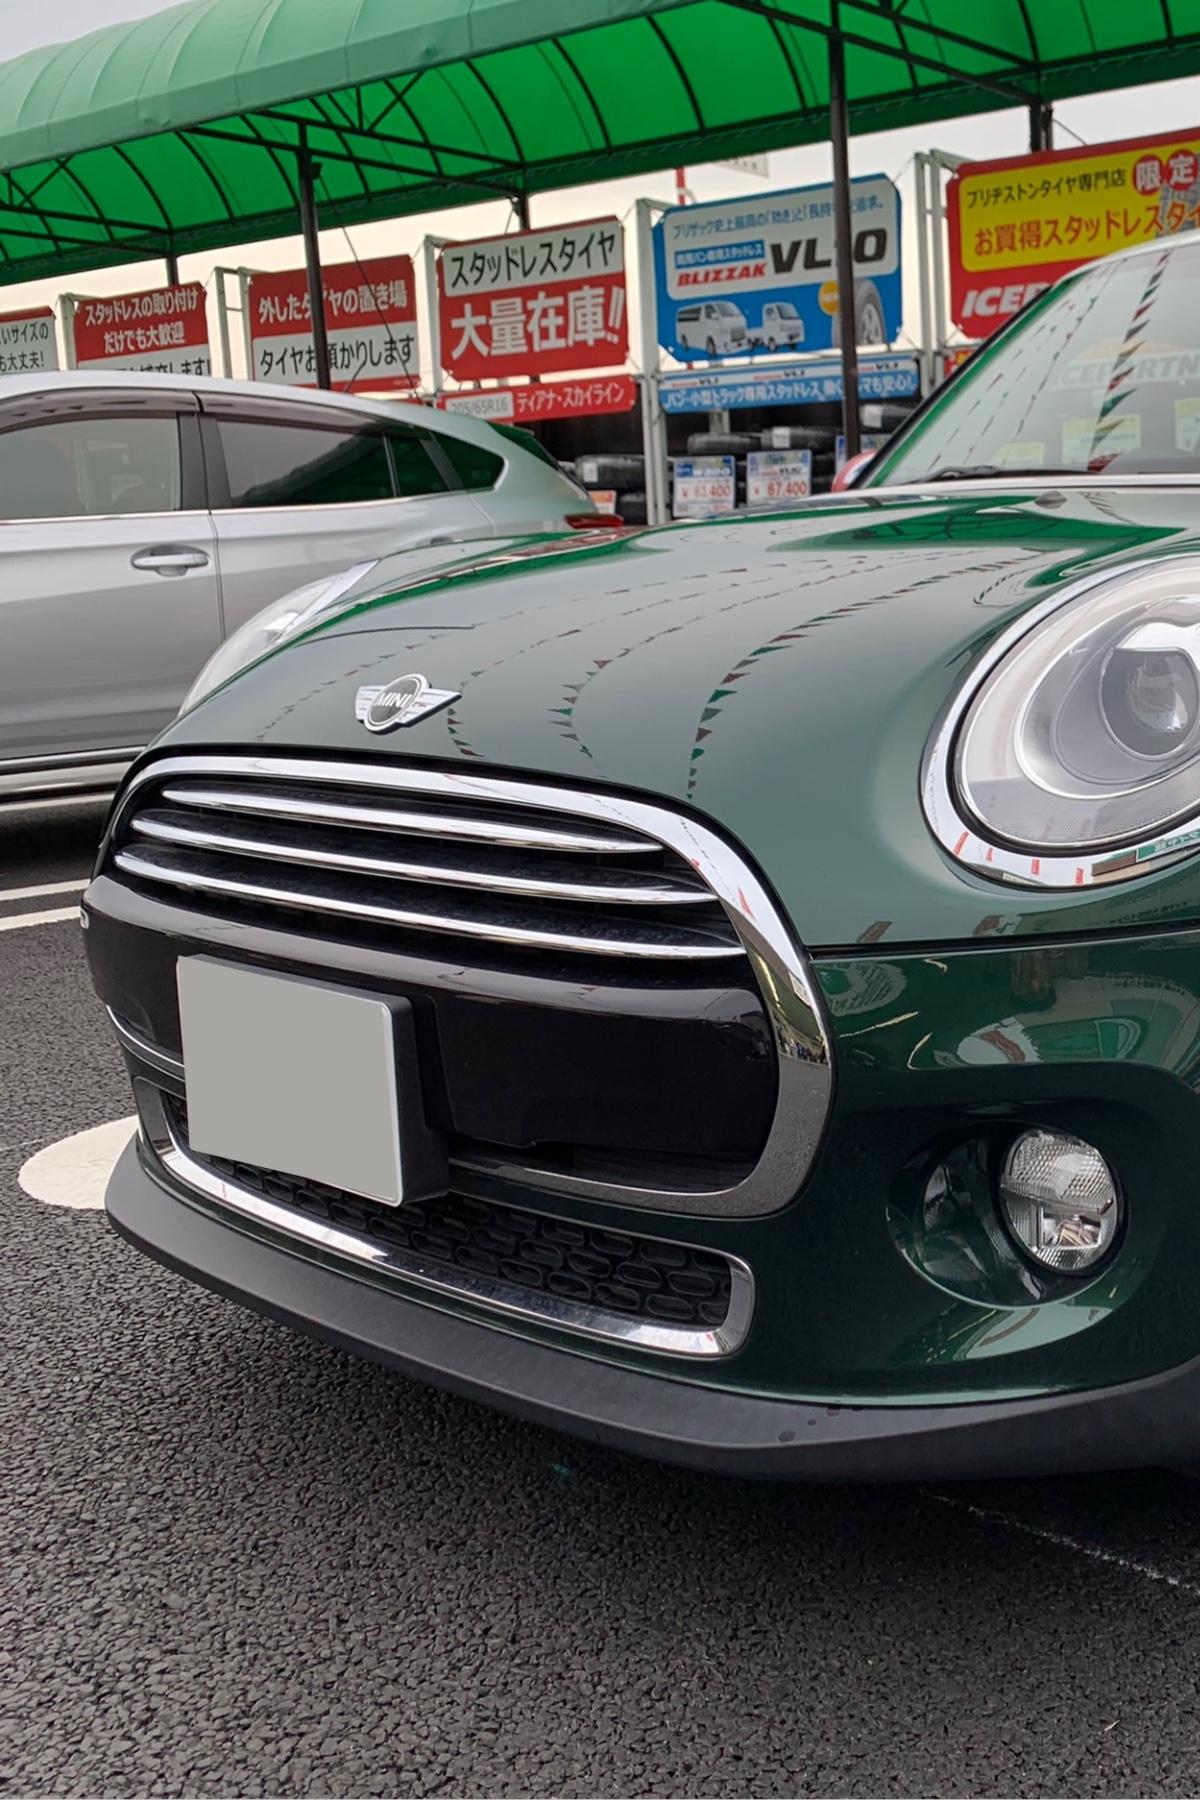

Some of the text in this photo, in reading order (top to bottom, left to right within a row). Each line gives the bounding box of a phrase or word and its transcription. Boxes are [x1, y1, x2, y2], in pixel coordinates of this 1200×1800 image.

[967, 168, 1127, 209] ブリヂストンタイヤ専門店
[1135, 154, 1195, 192] 限定
[452, 230, 615, 289] スタッドレスタイヤ
[770, 228, 888, 274] VL0
[677, 262, 768, 287] BLIZZAK
[85, 287, 199, 327] スタッドレスの取り付け
[258, 280, 407, 324] 外したタヤの置き場
[0, 322, 49, 345] いサイズの
[104, 321, 186, 354] だけでも大歓迎
[451, 285, 625, 360] 大量在庫!!
[518, 382, 625, 413] ティアナ・スカイライン
[374, 692, 413, 708] MINI
